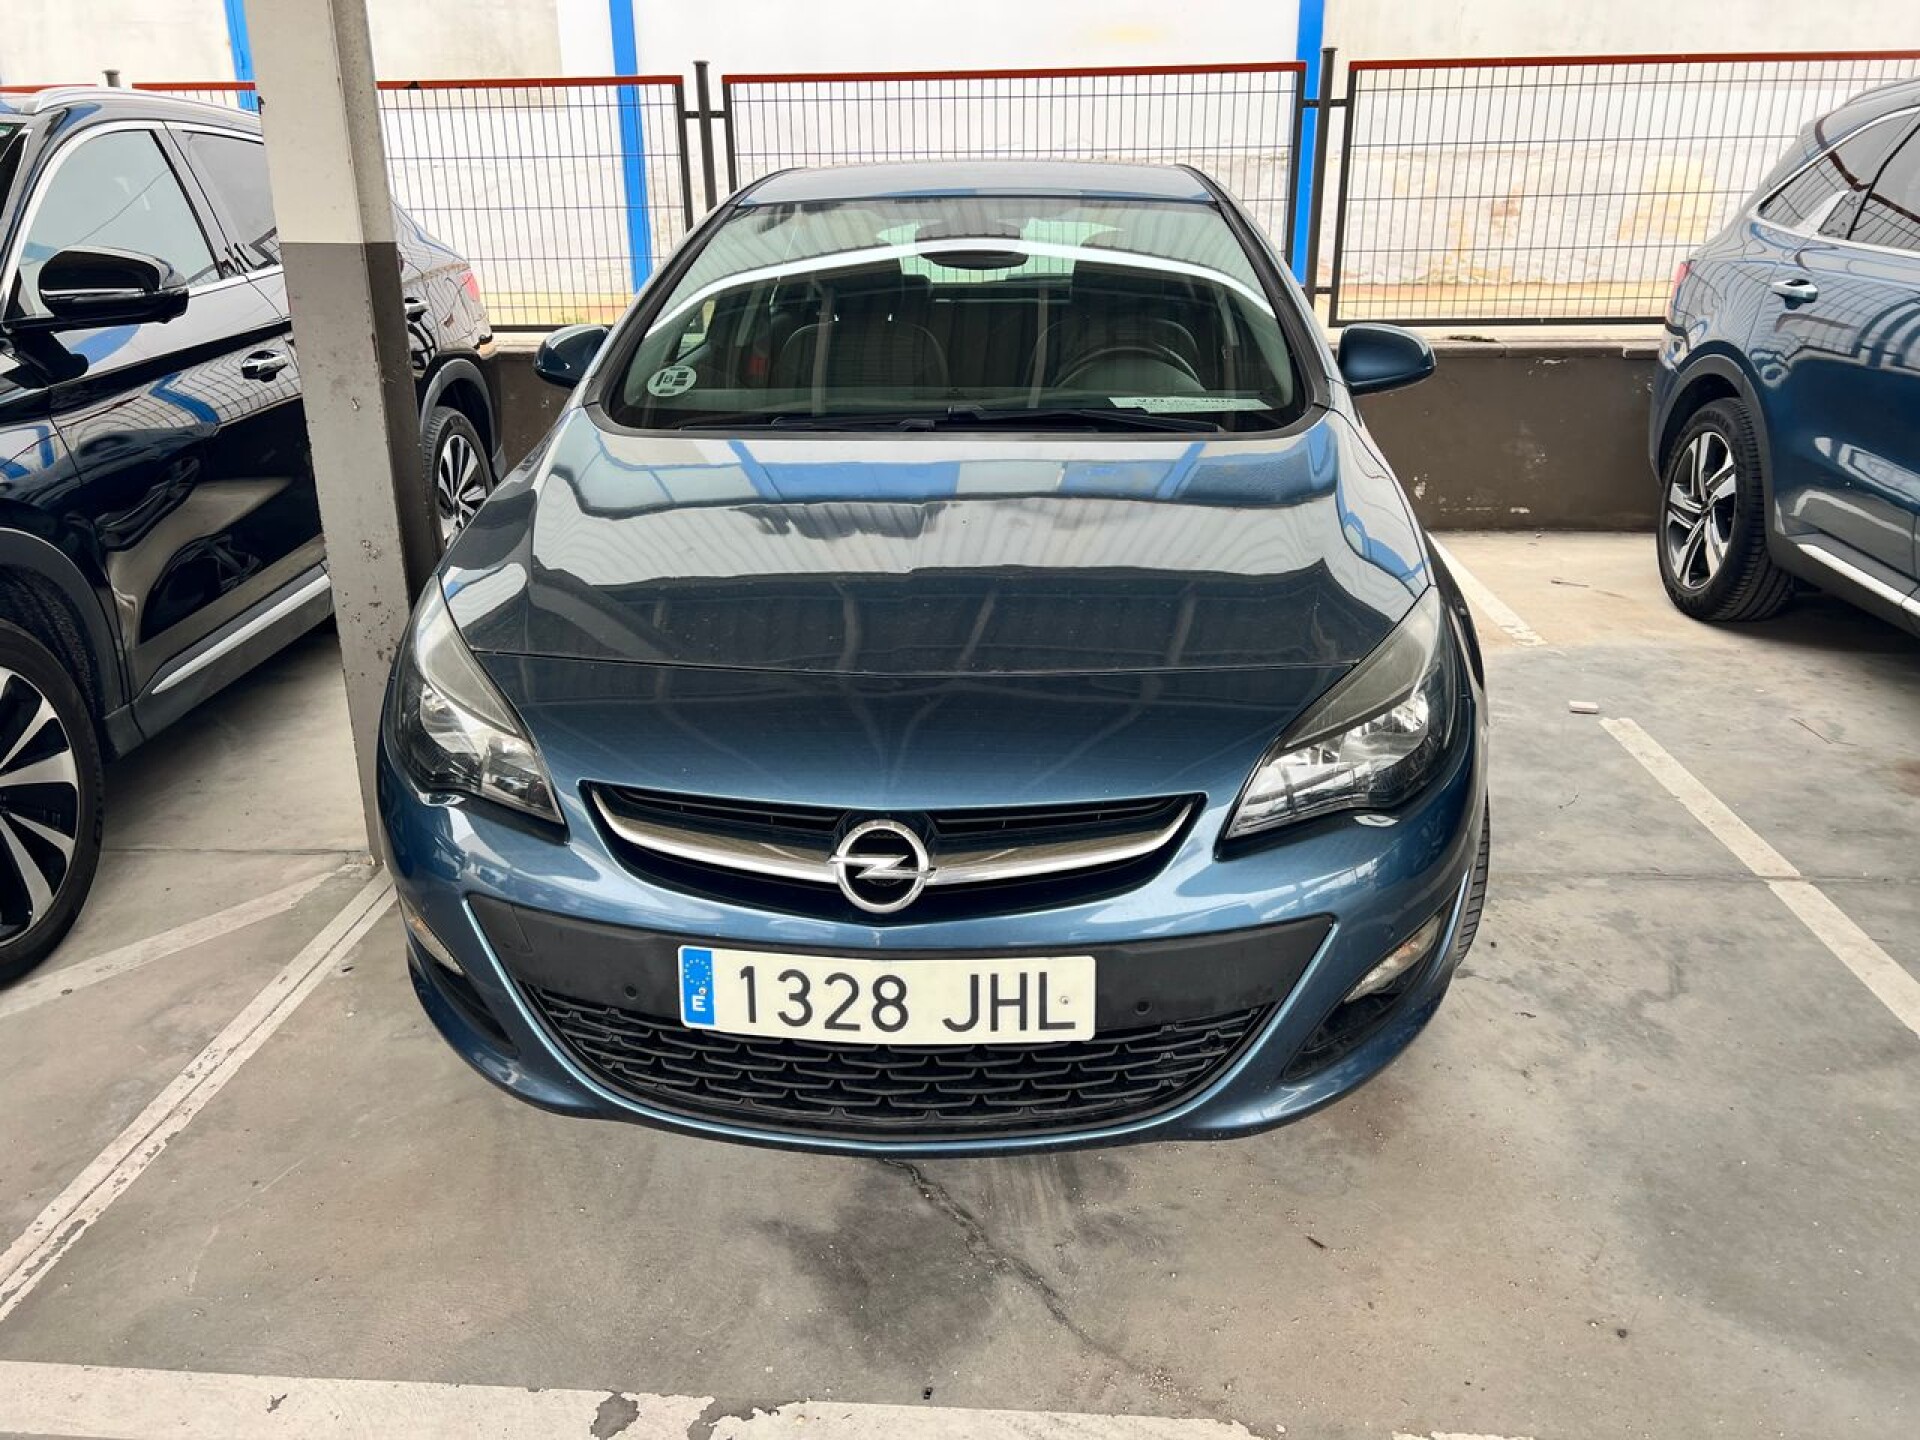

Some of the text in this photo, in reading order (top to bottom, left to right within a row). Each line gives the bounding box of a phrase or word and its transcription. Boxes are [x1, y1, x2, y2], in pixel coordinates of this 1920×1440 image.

[692, 995, 706, 1012] E
[739, 965, 1076, 1033] 1328 JHL
